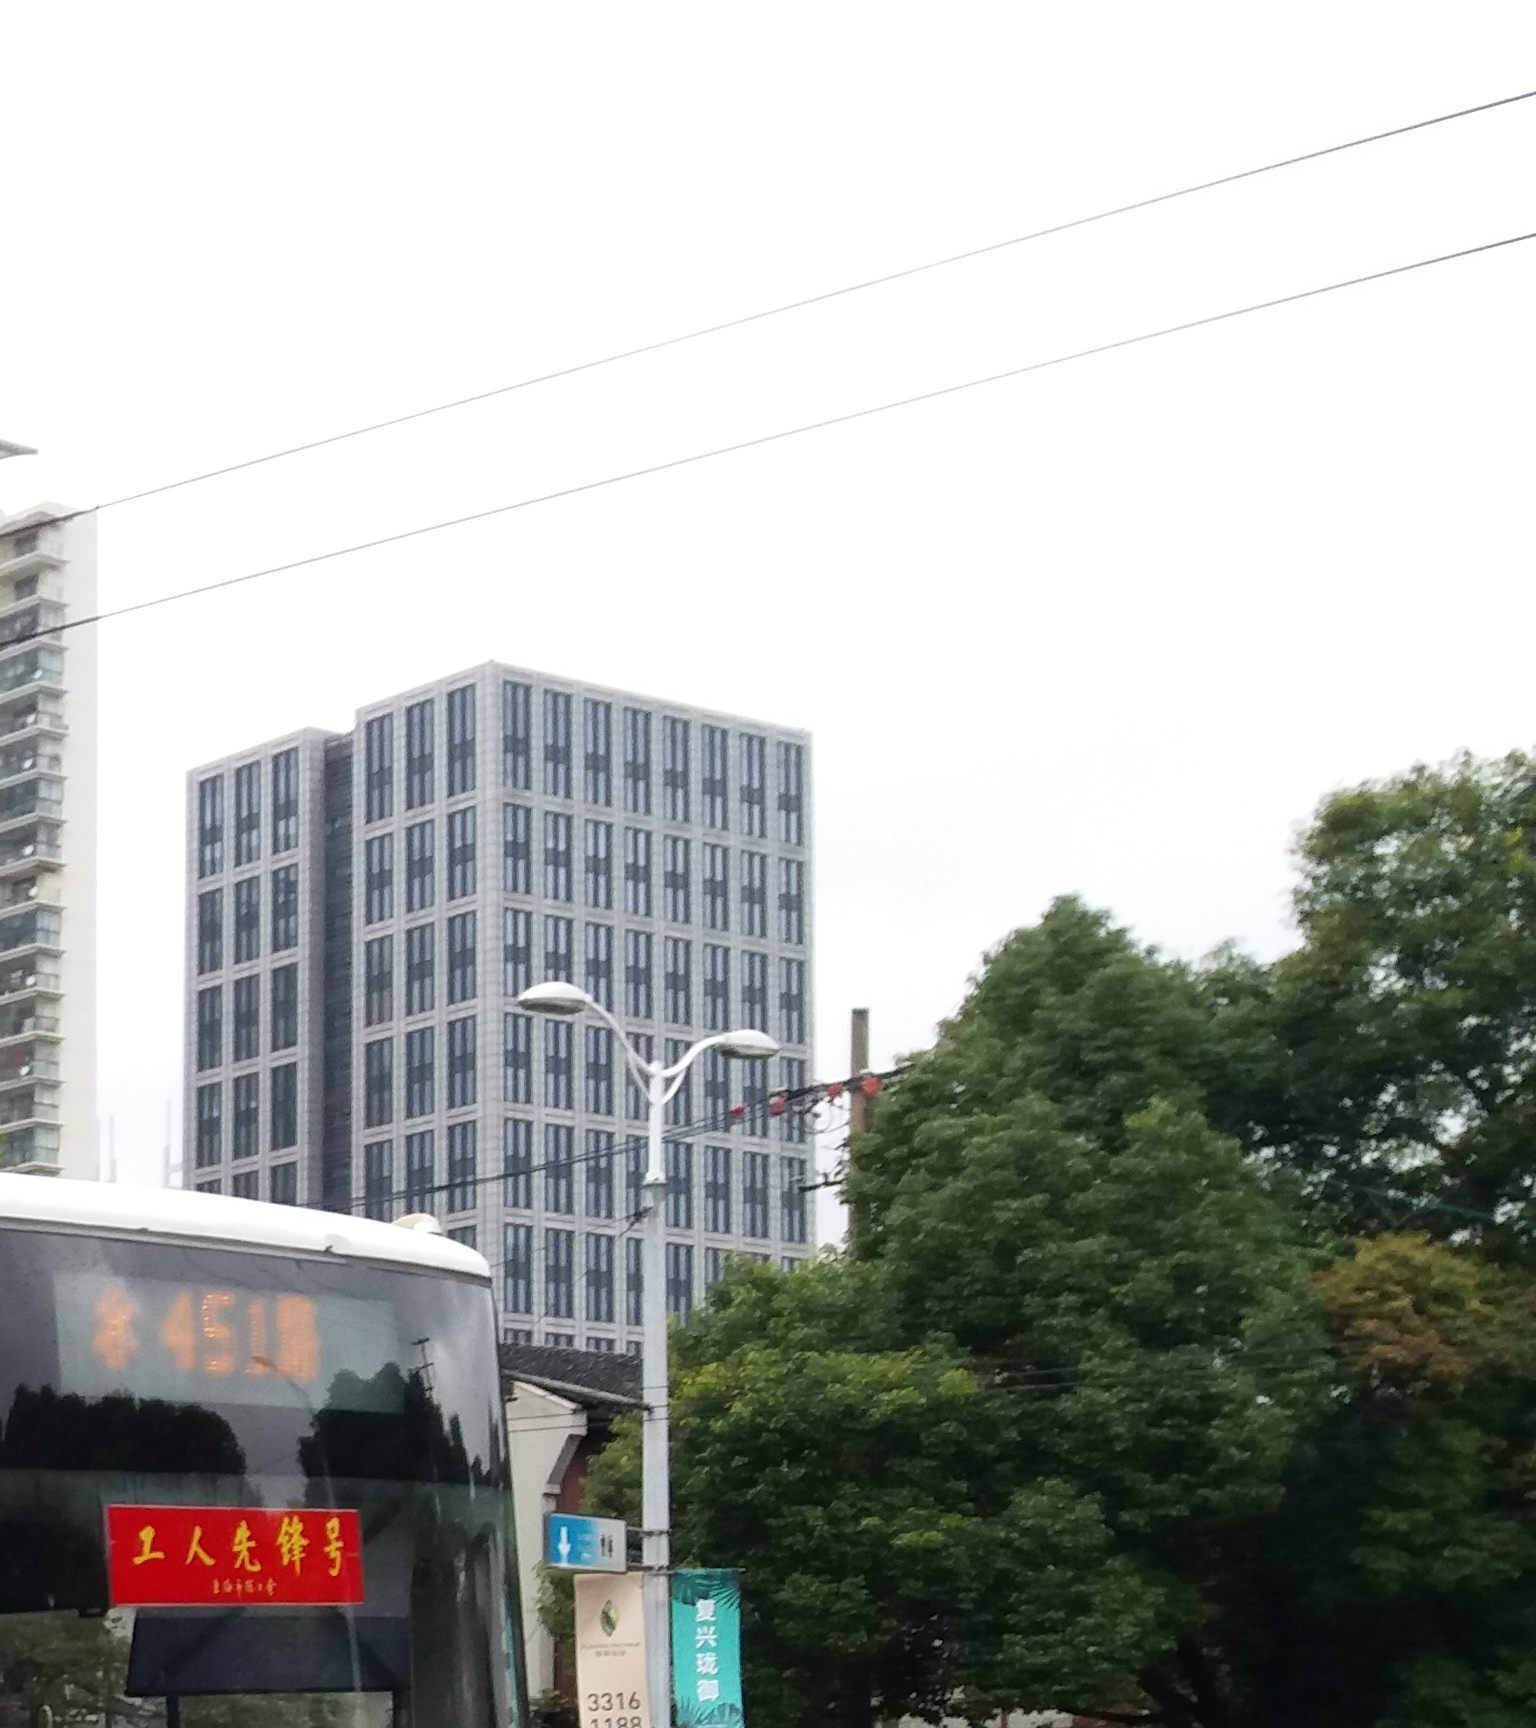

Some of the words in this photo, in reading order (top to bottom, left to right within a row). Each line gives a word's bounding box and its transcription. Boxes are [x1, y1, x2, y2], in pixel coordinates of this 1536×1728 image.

[132, 1515, 350, 1577] 工人先锋号
[586, 1691, 641, 1712] 3316
